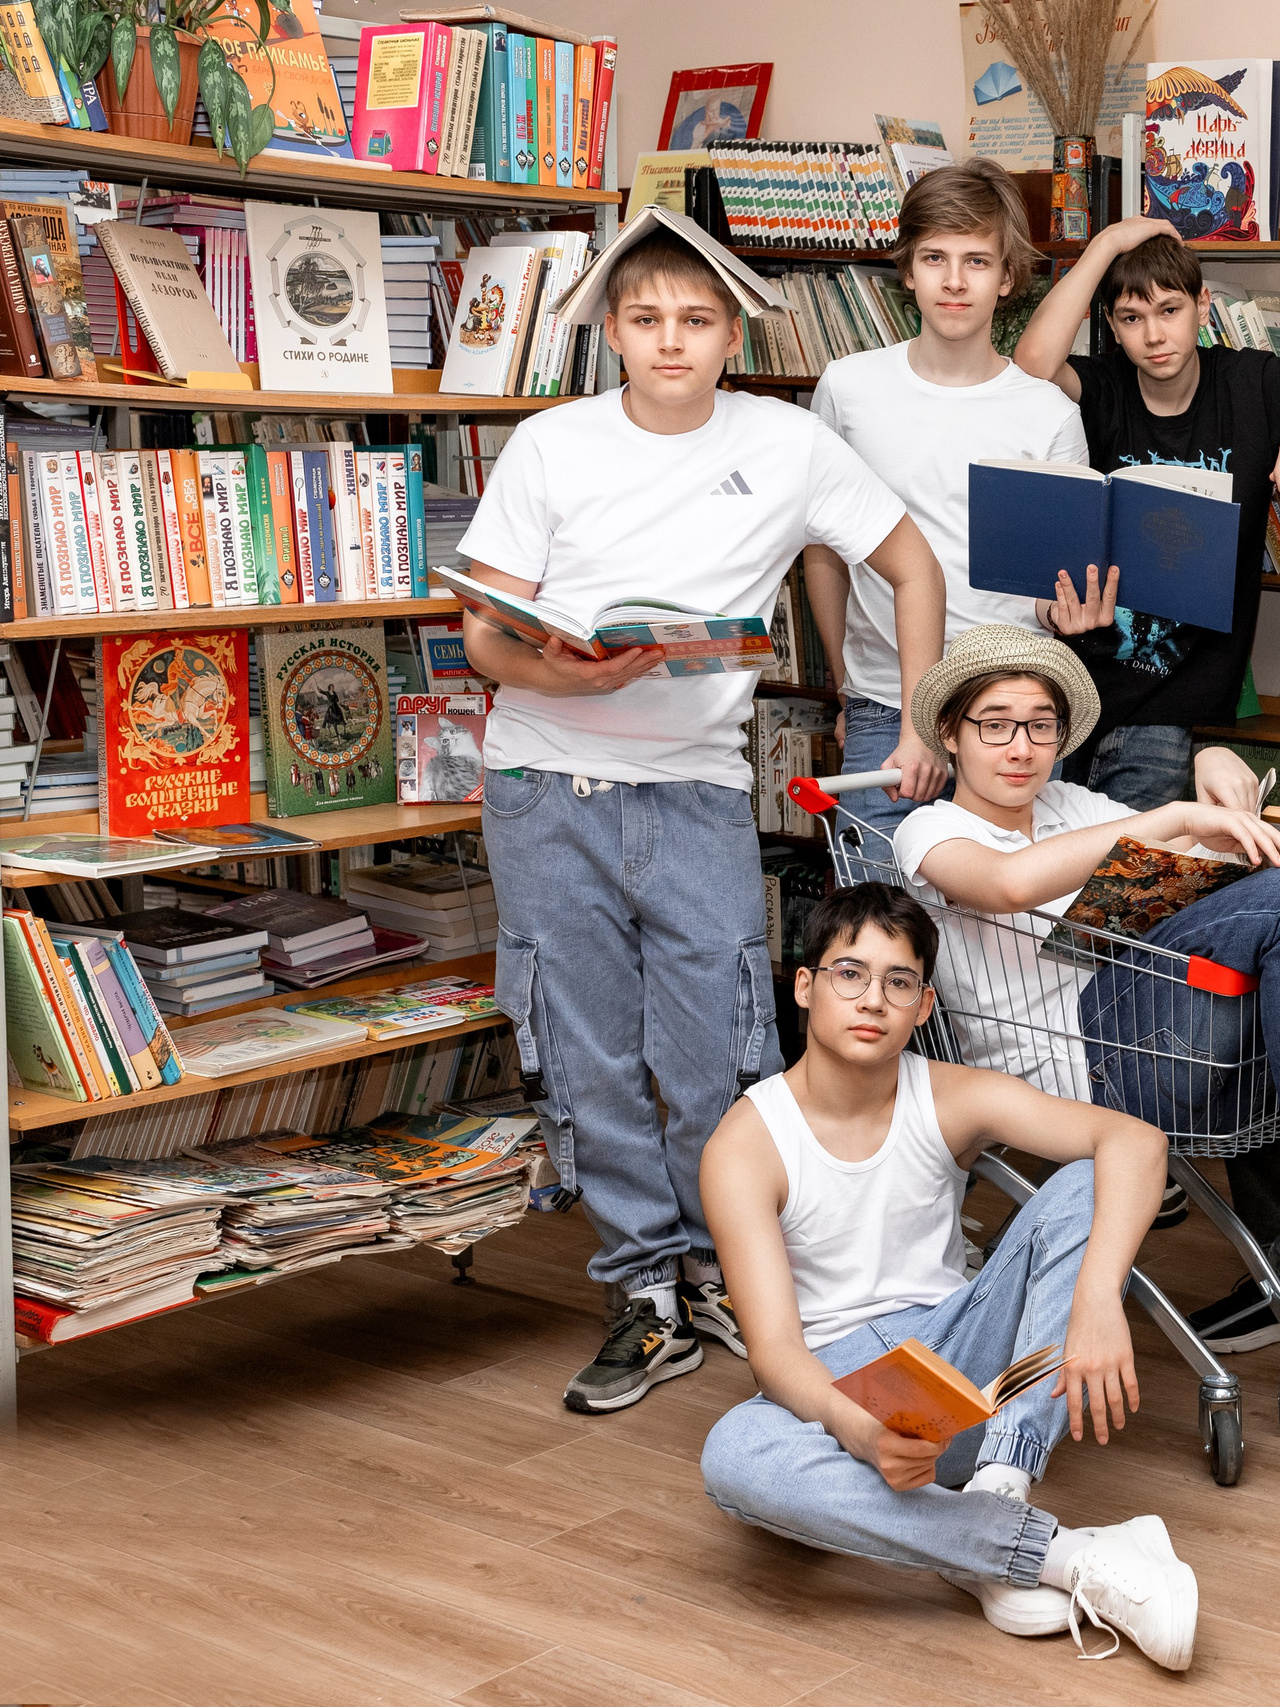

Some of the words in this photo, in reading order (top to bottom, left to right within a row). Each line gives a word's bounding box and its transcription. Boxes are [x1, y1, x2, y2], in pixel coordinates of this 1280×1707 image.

[246, 42, 328, 73] ПРИКАМЬЕ
[310, 76, 332, 86] ДОМ
[516, 113, 526, 140] ОБЖ
[283, 350, 315, 361] СТИХИ
[317, 351, 327, 362] О
[329, 351, 370, 364] РОДИНЕ
[28, 456, 36, 491] ТВОРЧЕСТВО
[344, 449, 357, 496] ХИМИЯ
[48, 485, 64, 518] МИР
[106, 479, 122, 511] МИР
[130, 483, 144, 517] МИР
[183, 478, 192, 503] ОБО
[215, 482, 230, 514] МИР
[235, 482, 249, 515] МИР
[377, 482, 389, 514] МИР
[394, 481, 407, 511] МИР
[68, 491, 84, 523] МИР
[34, 522, 42, 559] ПИСАТЕЛИ
[185, 512, 203, 553] ВСЁ
[220, 517, 237, 577] ПОЗНАЮ
[378, 516, 392, 575] ПОЗНАЮ
[395, 515, 409, 573] ПОЗНАЮ
[53, 520, 73, 582] ПОЗНАЮ
[73, 524, 92, 584] ПОЗНАЮ
[112, 515, 132, 583] ПОЗНАЮ
[134, 520, 153, 583] ПОЗНАЮ
[239, 520, 256, 581] ПОЗНАЮ
[37, 562, 49, 611] ЗНАМЕНИТЫЕ
[60, 584, 74, 597] Я
[81, 586, 95, 598] Я
[122, 583, 133, 595] Я
[141, 586, 155, 598] Я
[225, 580, 239, 591] Я
[243, 582, 257, 593] Я
[380, 576, 393, 588] Я
[397, 575, 410, 586] Я
[276, 638, 326, 682] РУССКАЯ
[330, 637, 381, 673] ИСТОРИЯ
[433, 643, 464, 660] СЕМЬ
[1132, 659, 1157, 674] DARK
[397, 695, 451, 715] ДРУГ
[447, 707, 476, 715] кошек
[125, 781, 239, 807] ВОЛШЕБНЫЕ
[144, 769, 223, 790] РУССКИЕ
[146, 798, 219, 821] СКАЗКИ
[765, 877, 777, 940] РАССКАЗЫ
